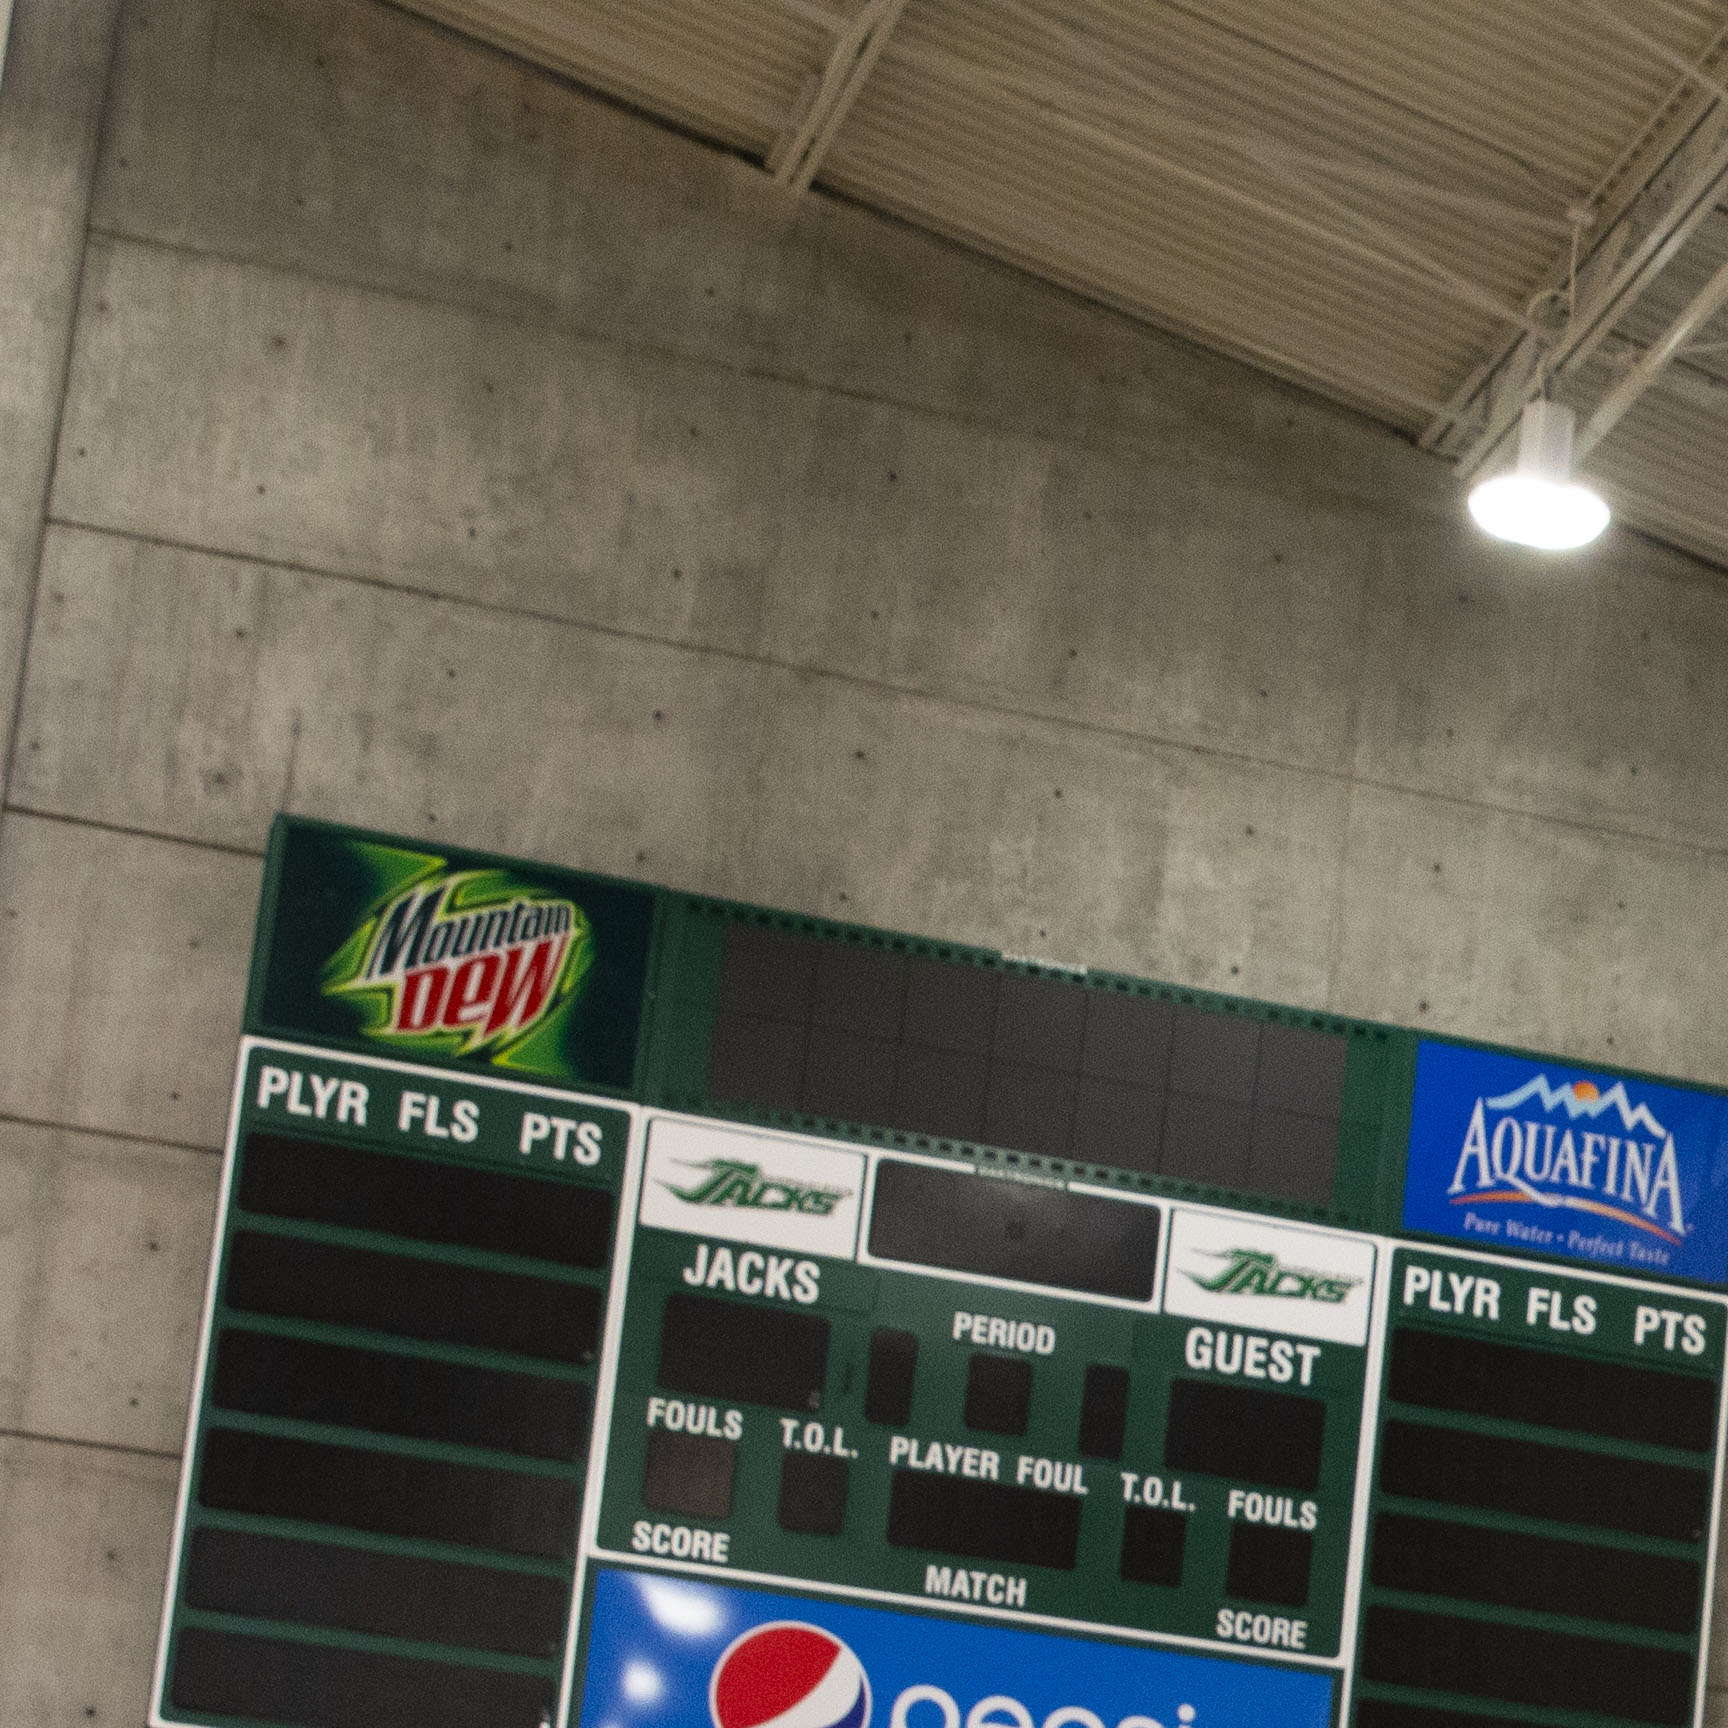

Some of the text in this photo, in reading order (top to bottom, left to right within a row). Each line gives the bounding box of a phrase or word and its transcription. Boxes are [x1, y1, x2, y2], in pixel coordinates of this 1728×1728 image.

[364, 884, 571, 981] Mountain
[256, 1065, 603, 1167] PLYR FLS PTS
[1448, 1097, 1686, 1235] AQUAFINA
[1506, 1219, 1553, 1245] Water
[683, 1243, 821, 1304] JACKS
[1403, 1265, 1707, 1356] PLYR FLS PTS
[952, 1311, 1056, 1355] PERIOD
[1184, 1326, 1321, 1386] GUEST
[646, 1397, 743, 1440] FOULS
[779, 1418, 858, 1459] T.O.L.
[889, 1436, 1089, 1495] PLAYER FOUL
[1120, 1472, 1196, 1512] T.O.L.
[1227, 1489, 1318, 1531] FOULS
[631, 1520, 731, 1565] SCORE
[925, 1565, 1027, 1608] MATCH
[1216, 1608, 1308, 1650] SCORE
